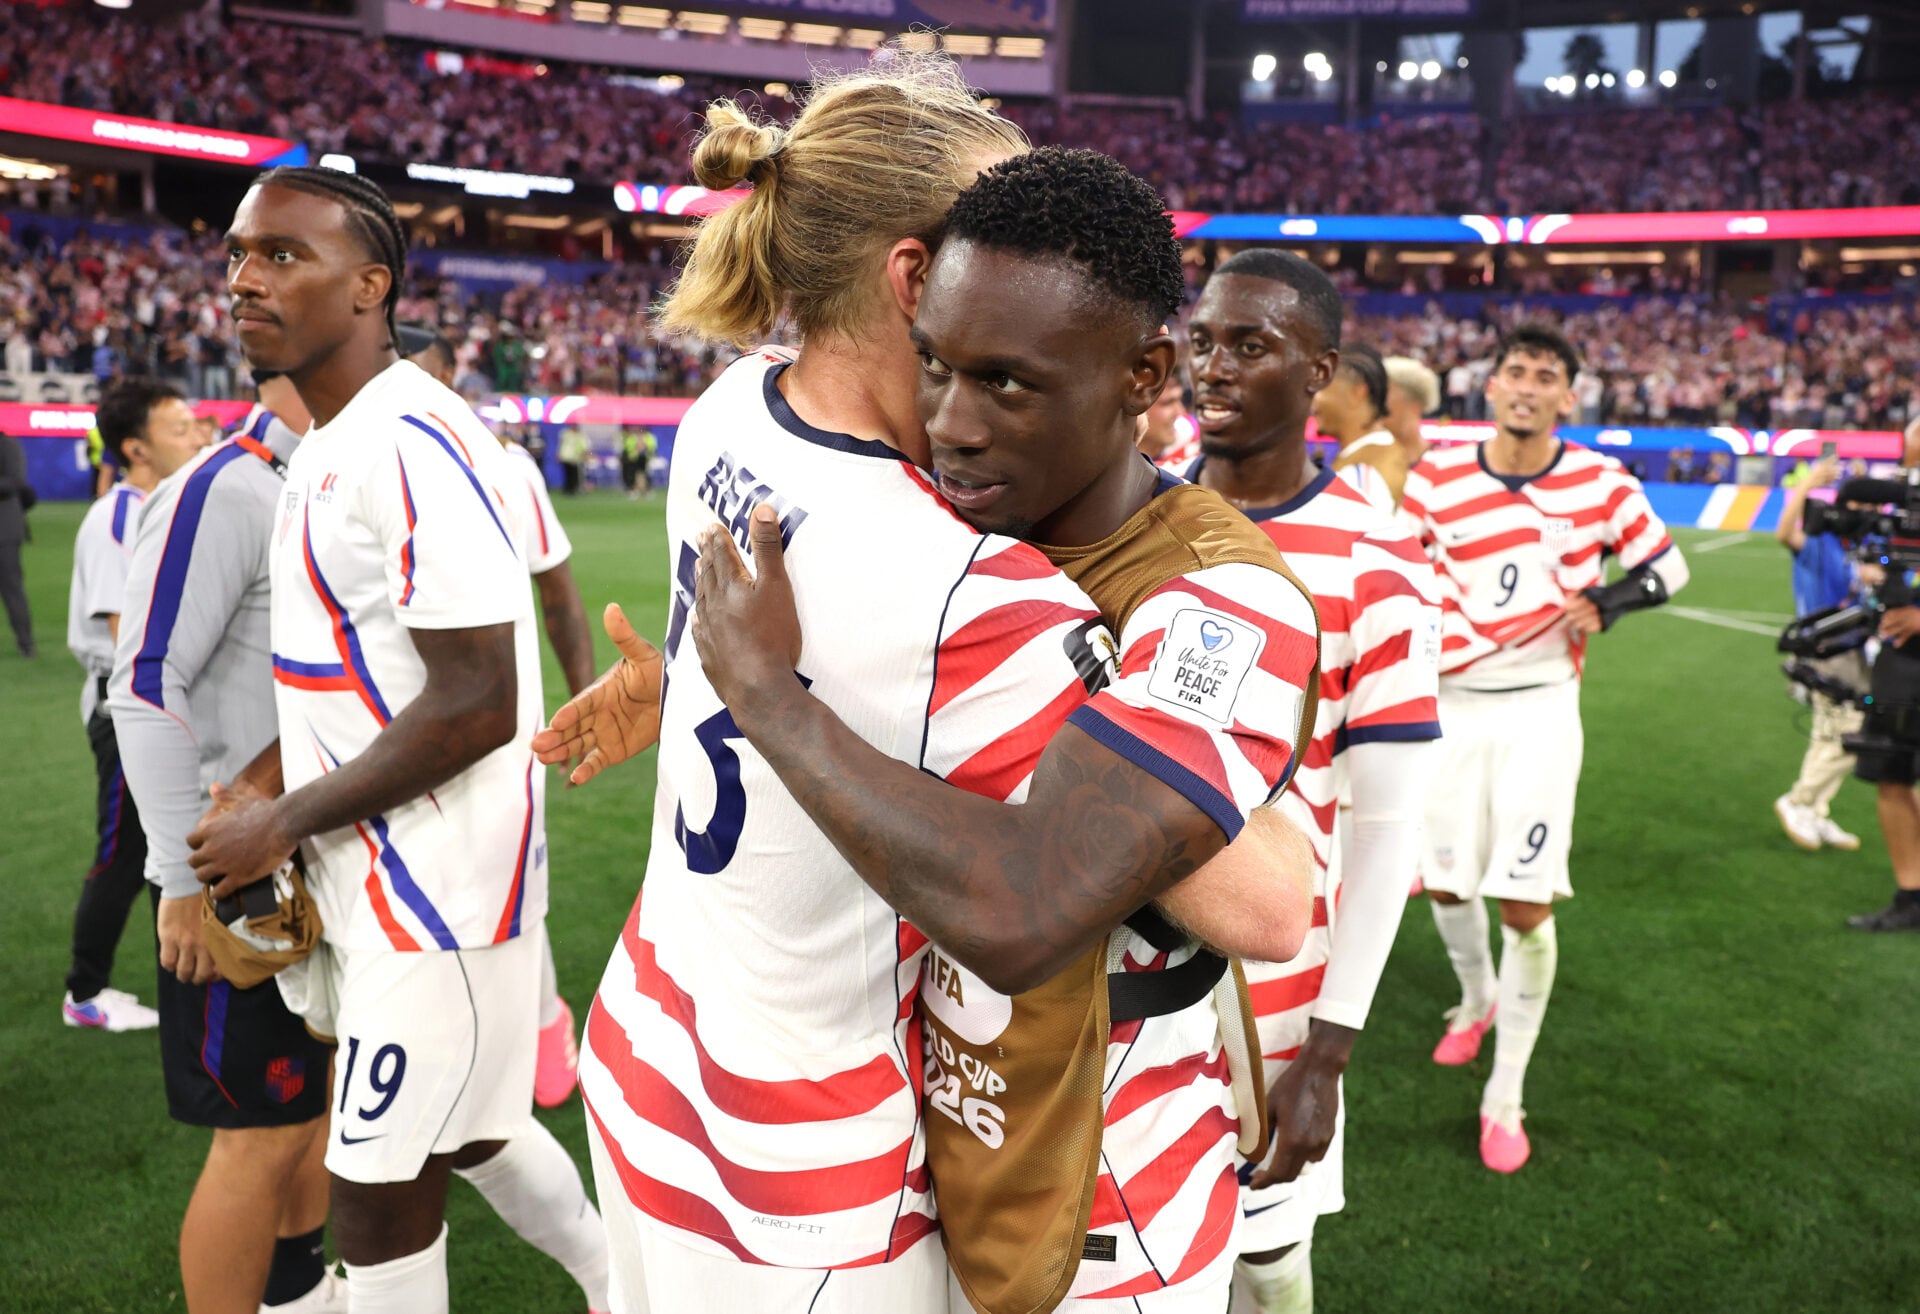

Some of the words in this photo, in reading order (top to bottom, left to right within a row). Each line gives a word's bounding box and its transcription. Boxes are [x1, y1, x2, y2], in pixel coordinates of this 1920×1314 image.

[1494, 563, 1518, 607] 9
[1174, 666, 1222, 698] PEACE
[1178, 647, 1211, 670] Unite
[1211, 659, 1229, 677] For
[1178, 690, 1202, 705] FIFA
[1519, 822, 1547, 863] 9
[930, 949, 964, 1008] IFA
[340, 1036, 407, 1121] 19
[959, 1053, 1007, 1097] CUP
[923, 1054, 1006, 1150] 026
[751, 1215, 826, 1235] AERO-FIT
